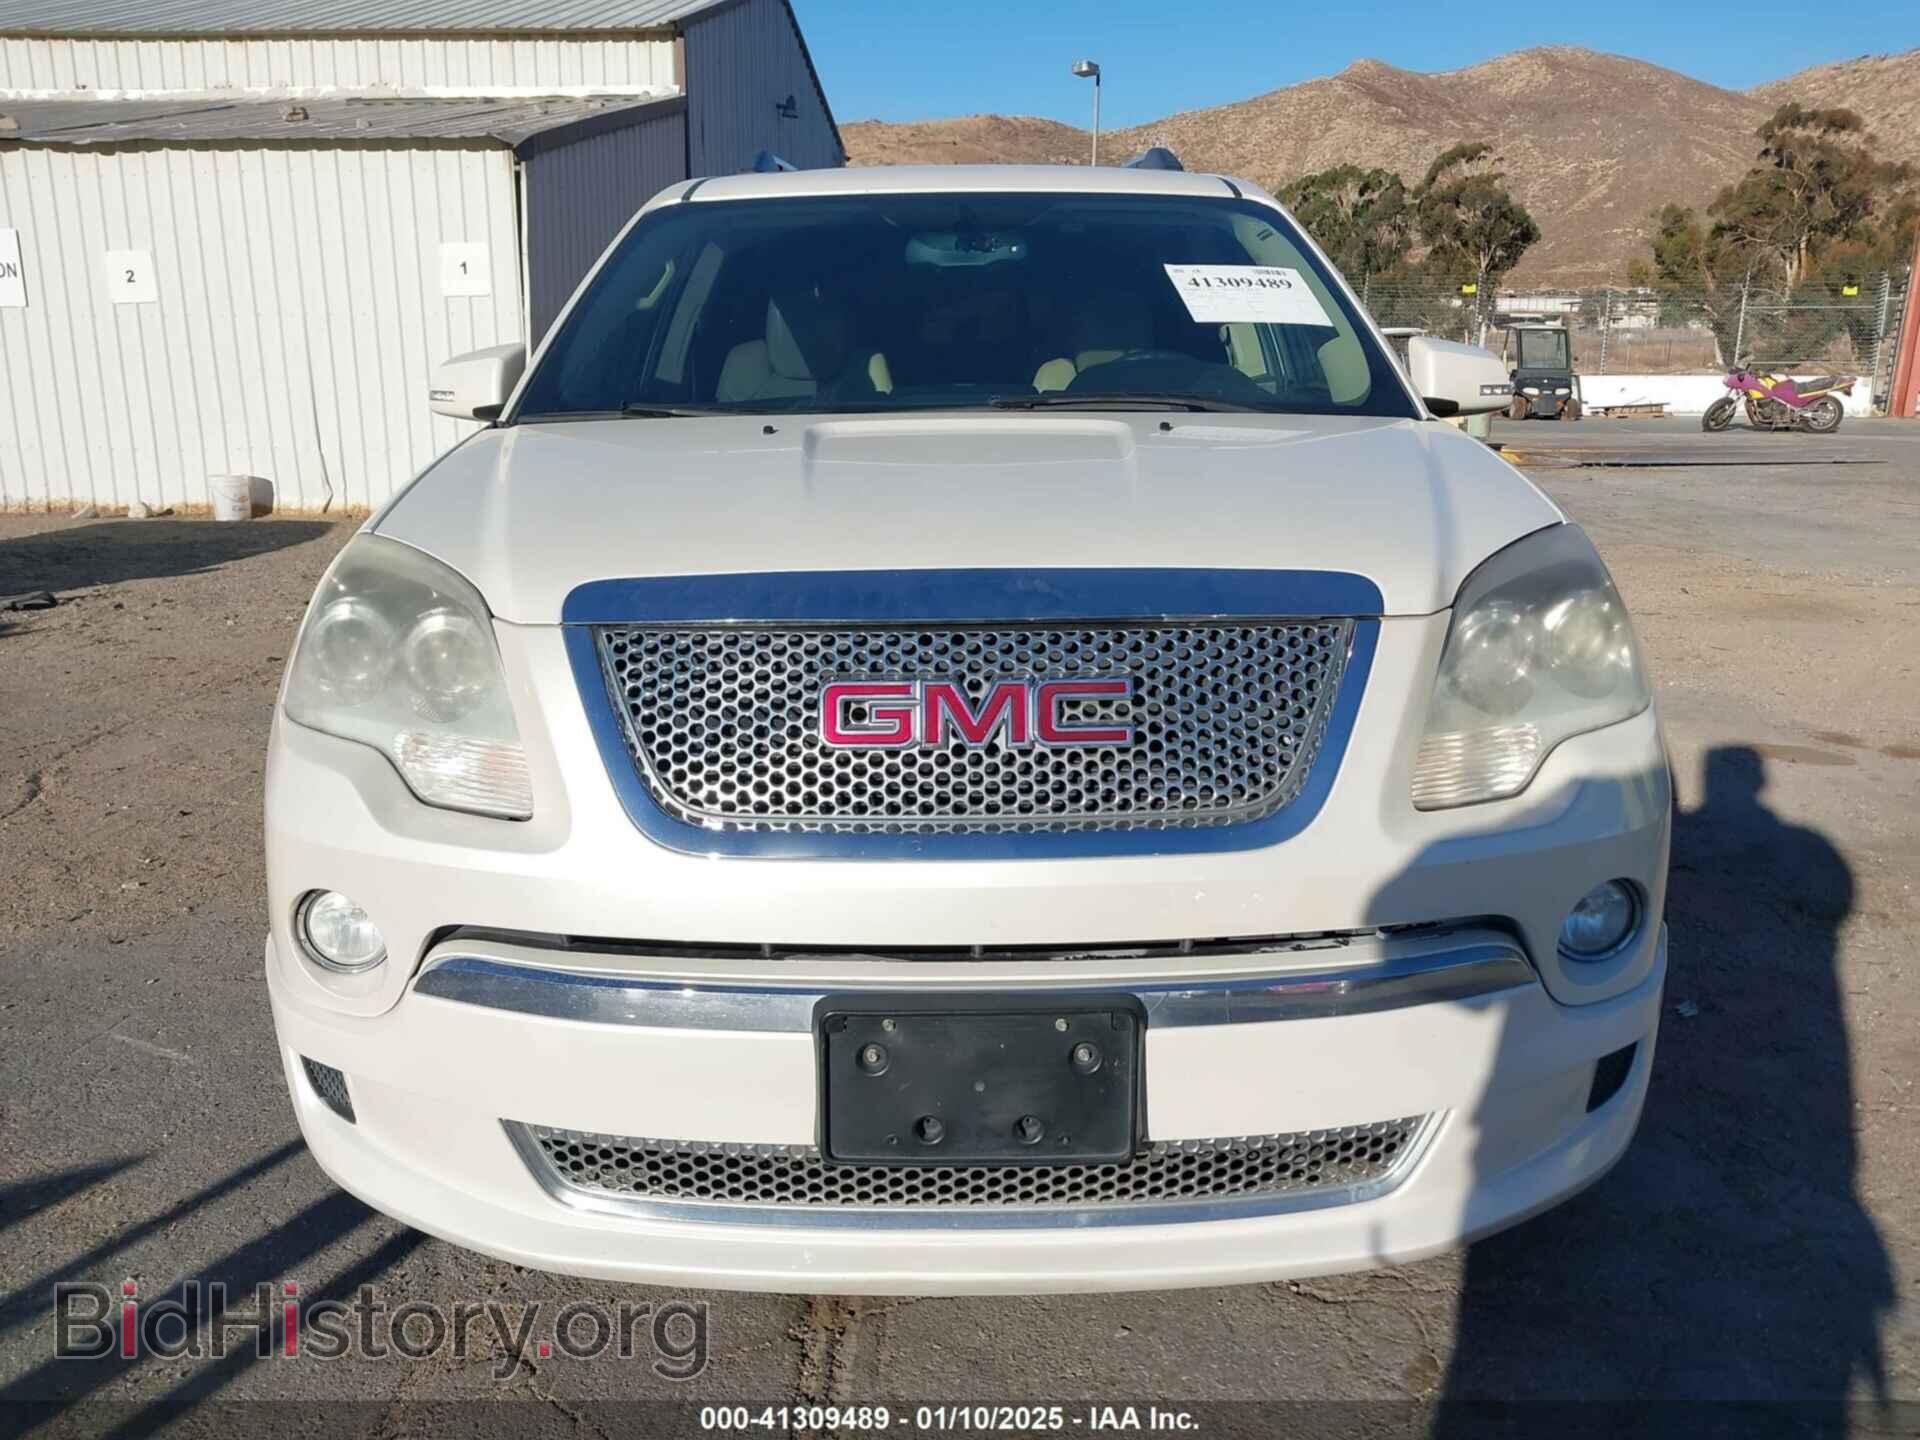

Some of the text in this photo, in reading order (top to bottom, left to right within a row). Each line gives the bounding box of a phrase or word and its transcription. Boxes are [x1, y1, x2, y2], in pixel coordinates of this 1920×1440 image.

[459, 261, 468, 275] 1
[125, 269, 136, 284] 2
[1187, 276, 1293, 290] 41309489
[820, 680, 1133, 748] GMC
